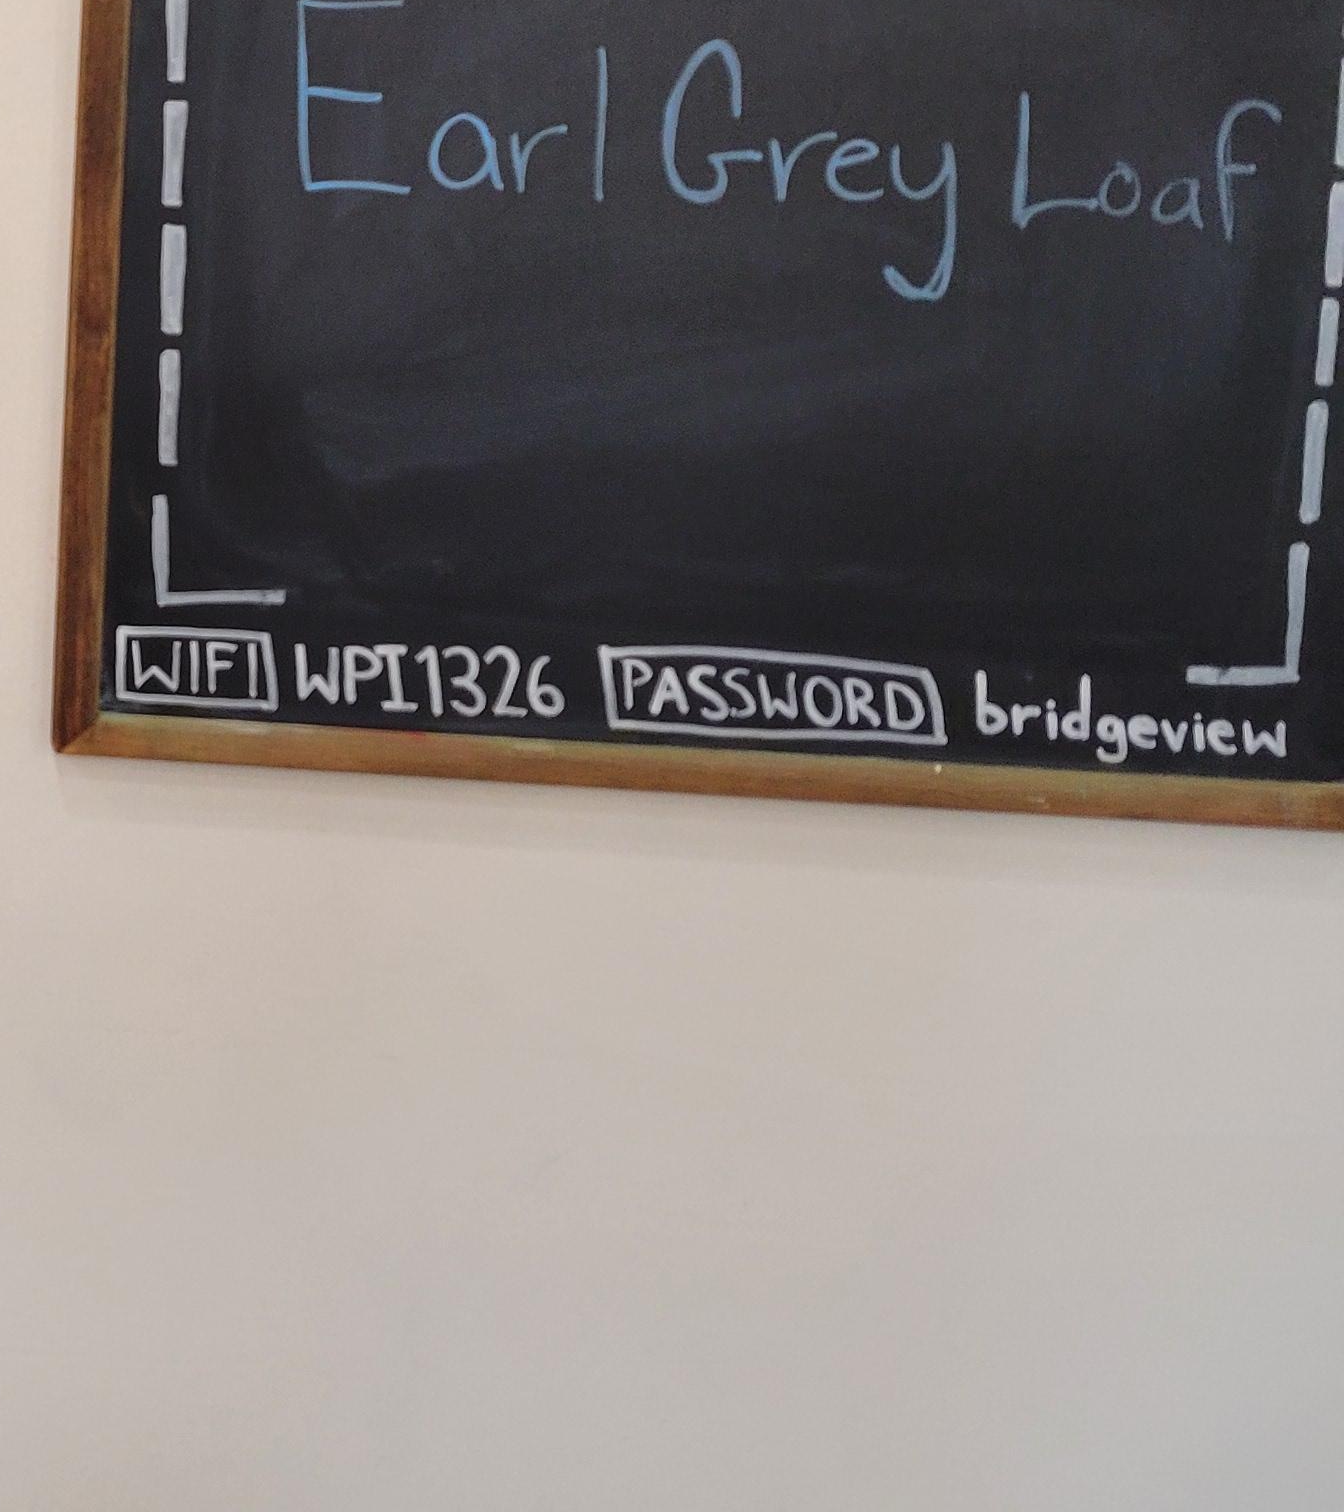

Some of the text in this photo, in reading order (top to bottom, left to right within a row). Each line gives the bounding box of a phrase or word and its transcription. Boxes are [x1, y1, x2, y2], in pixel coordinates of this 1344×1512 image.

[663, 38, 958, 301] Grey
[1012, 91, 1283, 243] Loaf
[131, 639, 1287, 764] WIFI WPI1326 PASSWORD bridgeview
